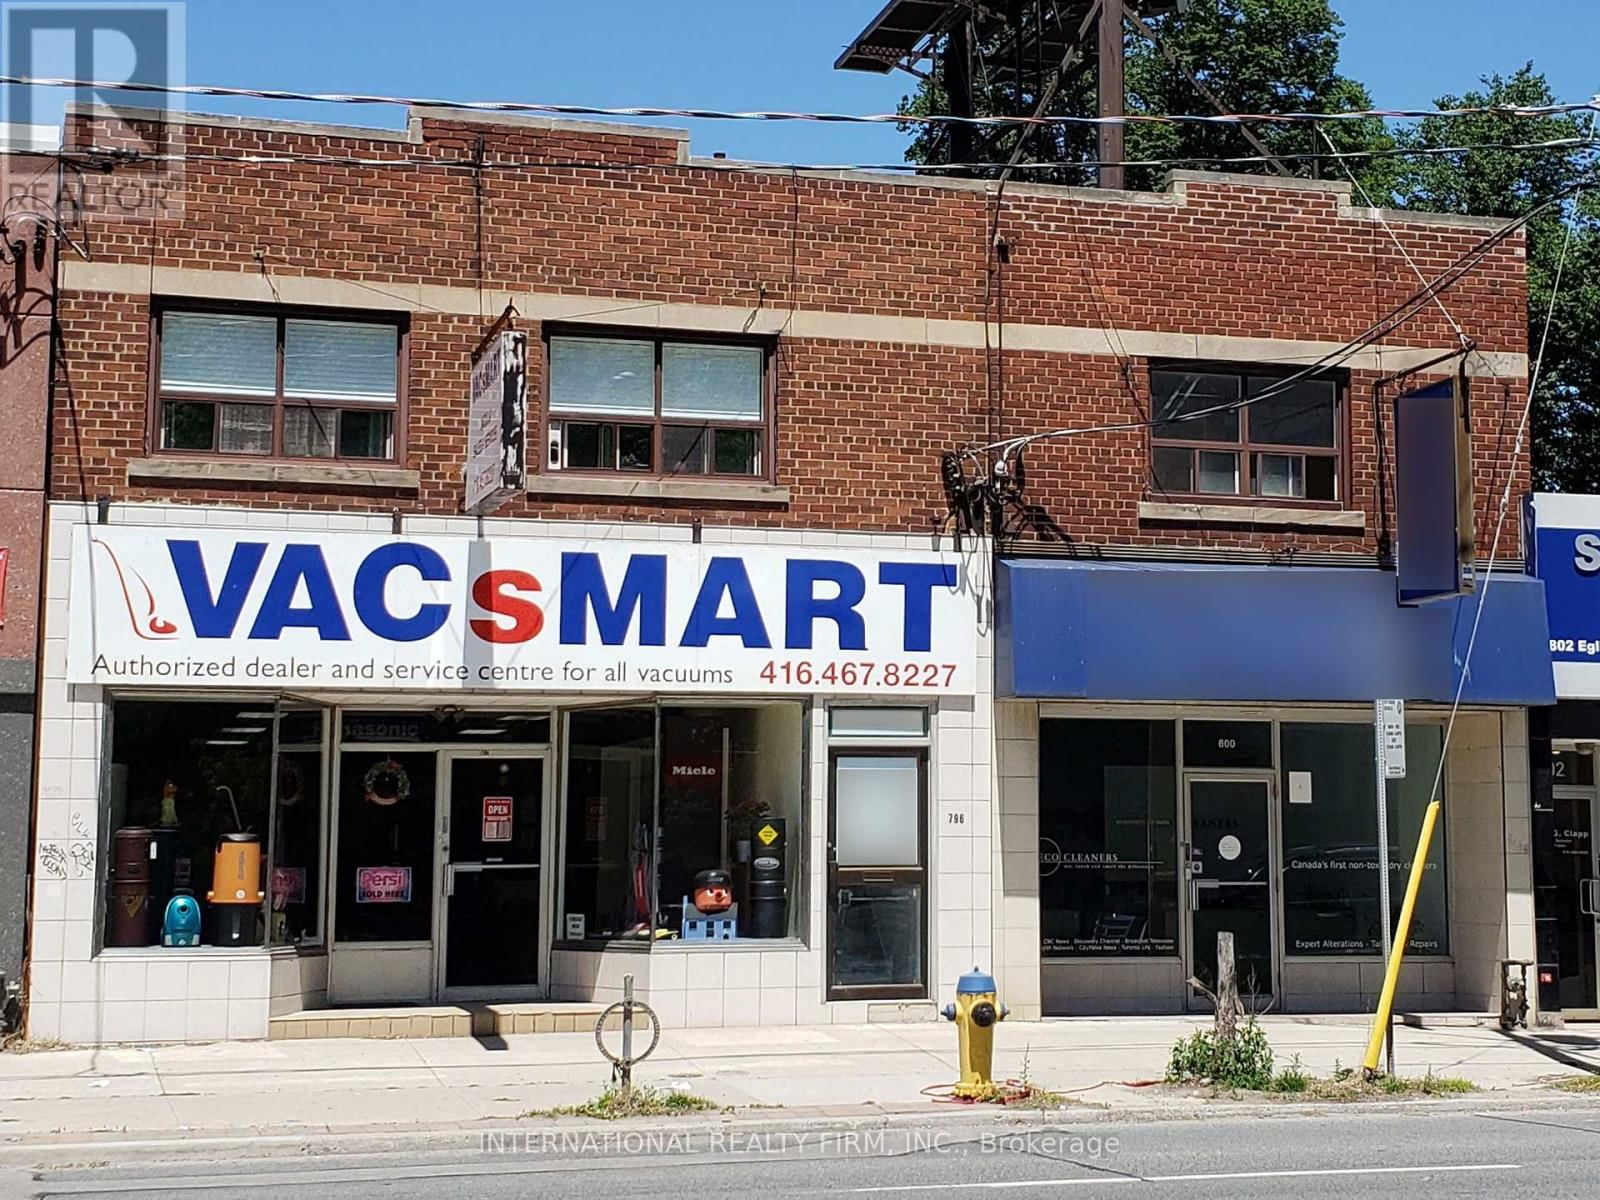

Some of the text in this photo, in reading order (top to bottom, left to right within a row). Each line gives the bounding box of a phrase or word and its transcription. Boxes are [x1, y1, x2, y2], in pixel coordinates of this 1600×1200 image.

[91, 653, 957, 687] Authorized dealer and service centre for all vacuums 416.467.8227
[947, 813, 965, 824] 796
[1063, 852, 1119, 861] CLEANERS
[1291, 860, 1329, 870] Canada's
[1330, 860, 1347, 869] first
[1348, 861, 1381, 870] non-tox
[1389, 861, 1402, 871] dry
[1296, 939, 1324, 950] Expert
[1324, 939, 1364, 949] Alterations
[1409, 939, 1438, 950] Repairs
